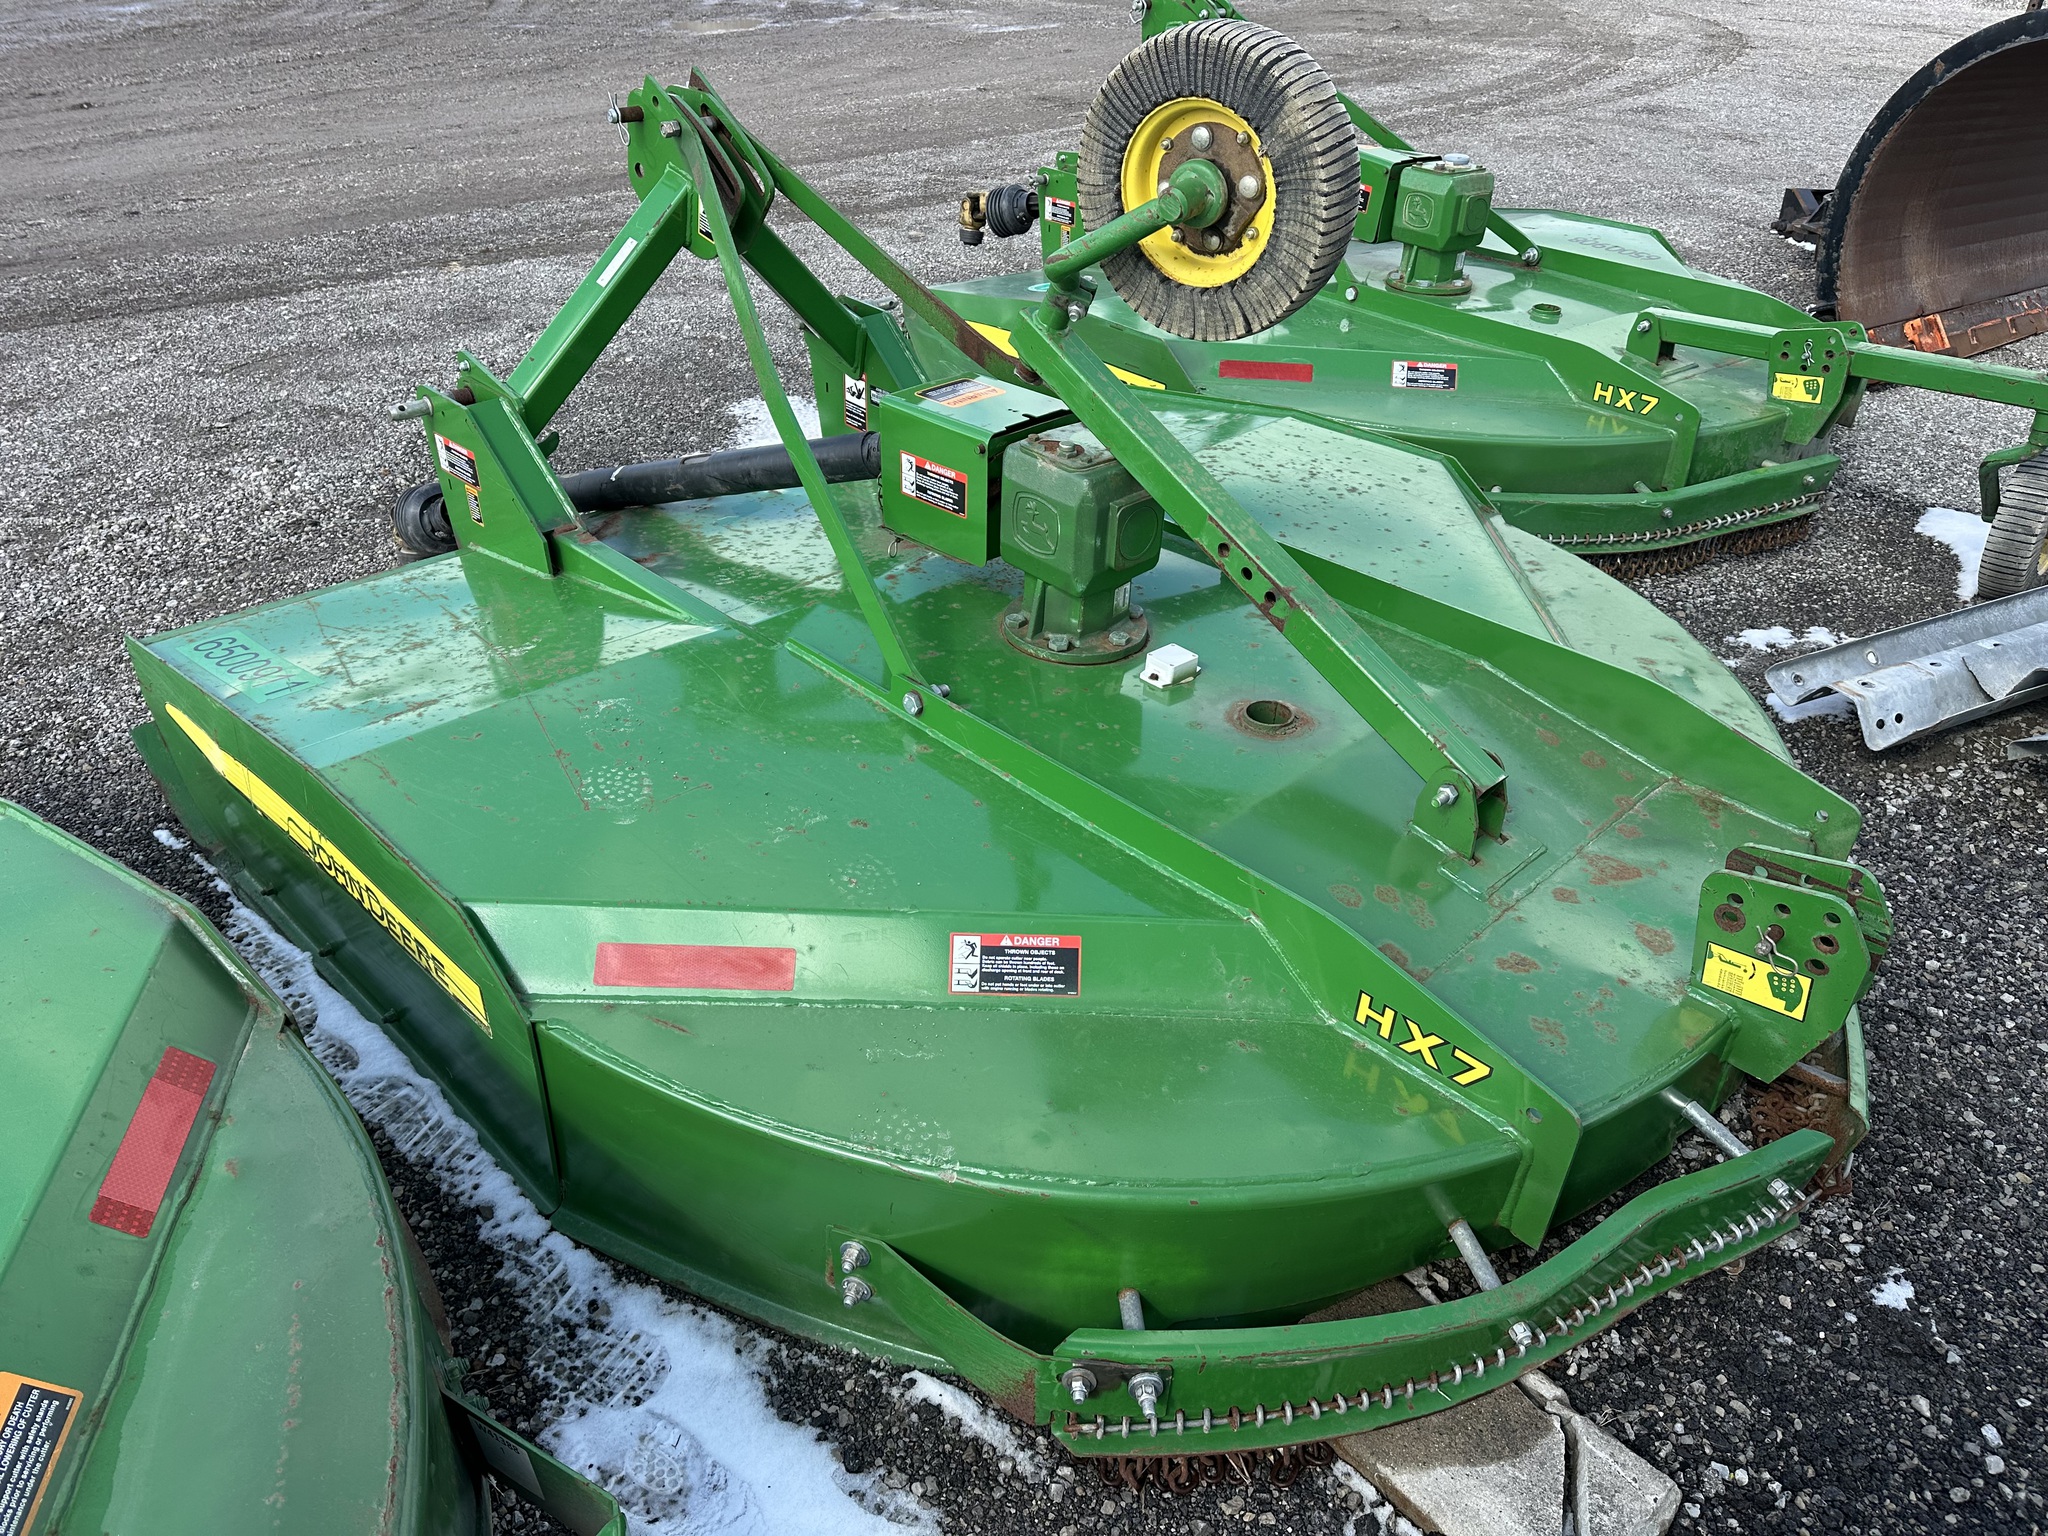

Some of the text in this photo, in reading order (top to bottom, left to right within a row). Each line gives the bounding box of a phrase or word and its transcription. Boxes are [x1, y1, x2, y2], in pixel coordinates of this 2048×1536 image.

[1592, 380, 1660, 416] HX7
[931, 463, 956, 479] DANGER
[308, 832, 451, 988] JOHN DEERE
[1014, 936, 1060, 946] DANGER
[1353, 989, 1494, 1088] HX7
[0, 1389, 40, 1471] LOWERING OF CUTTER
[2, 1426, 13, 1438] OR
[7, 1401, 24, 1426] DEATH
[10, 1461, 23, 1483] cutter
[19, 1445, 29, 1460] with
[26, 1422, 40, 1444] safety
[36, 1400, 49, 1422] stands
[10, 1489, 21, 1508] prior
[17, 1480, 24, 1488] to
[21, 1446, 40, 1479] servicing
[35, 1437, 42, 1446] or
[39, 1400, 60, 1437] performing
[6, 1440, 51, 1536] aintenance under the cutter.
